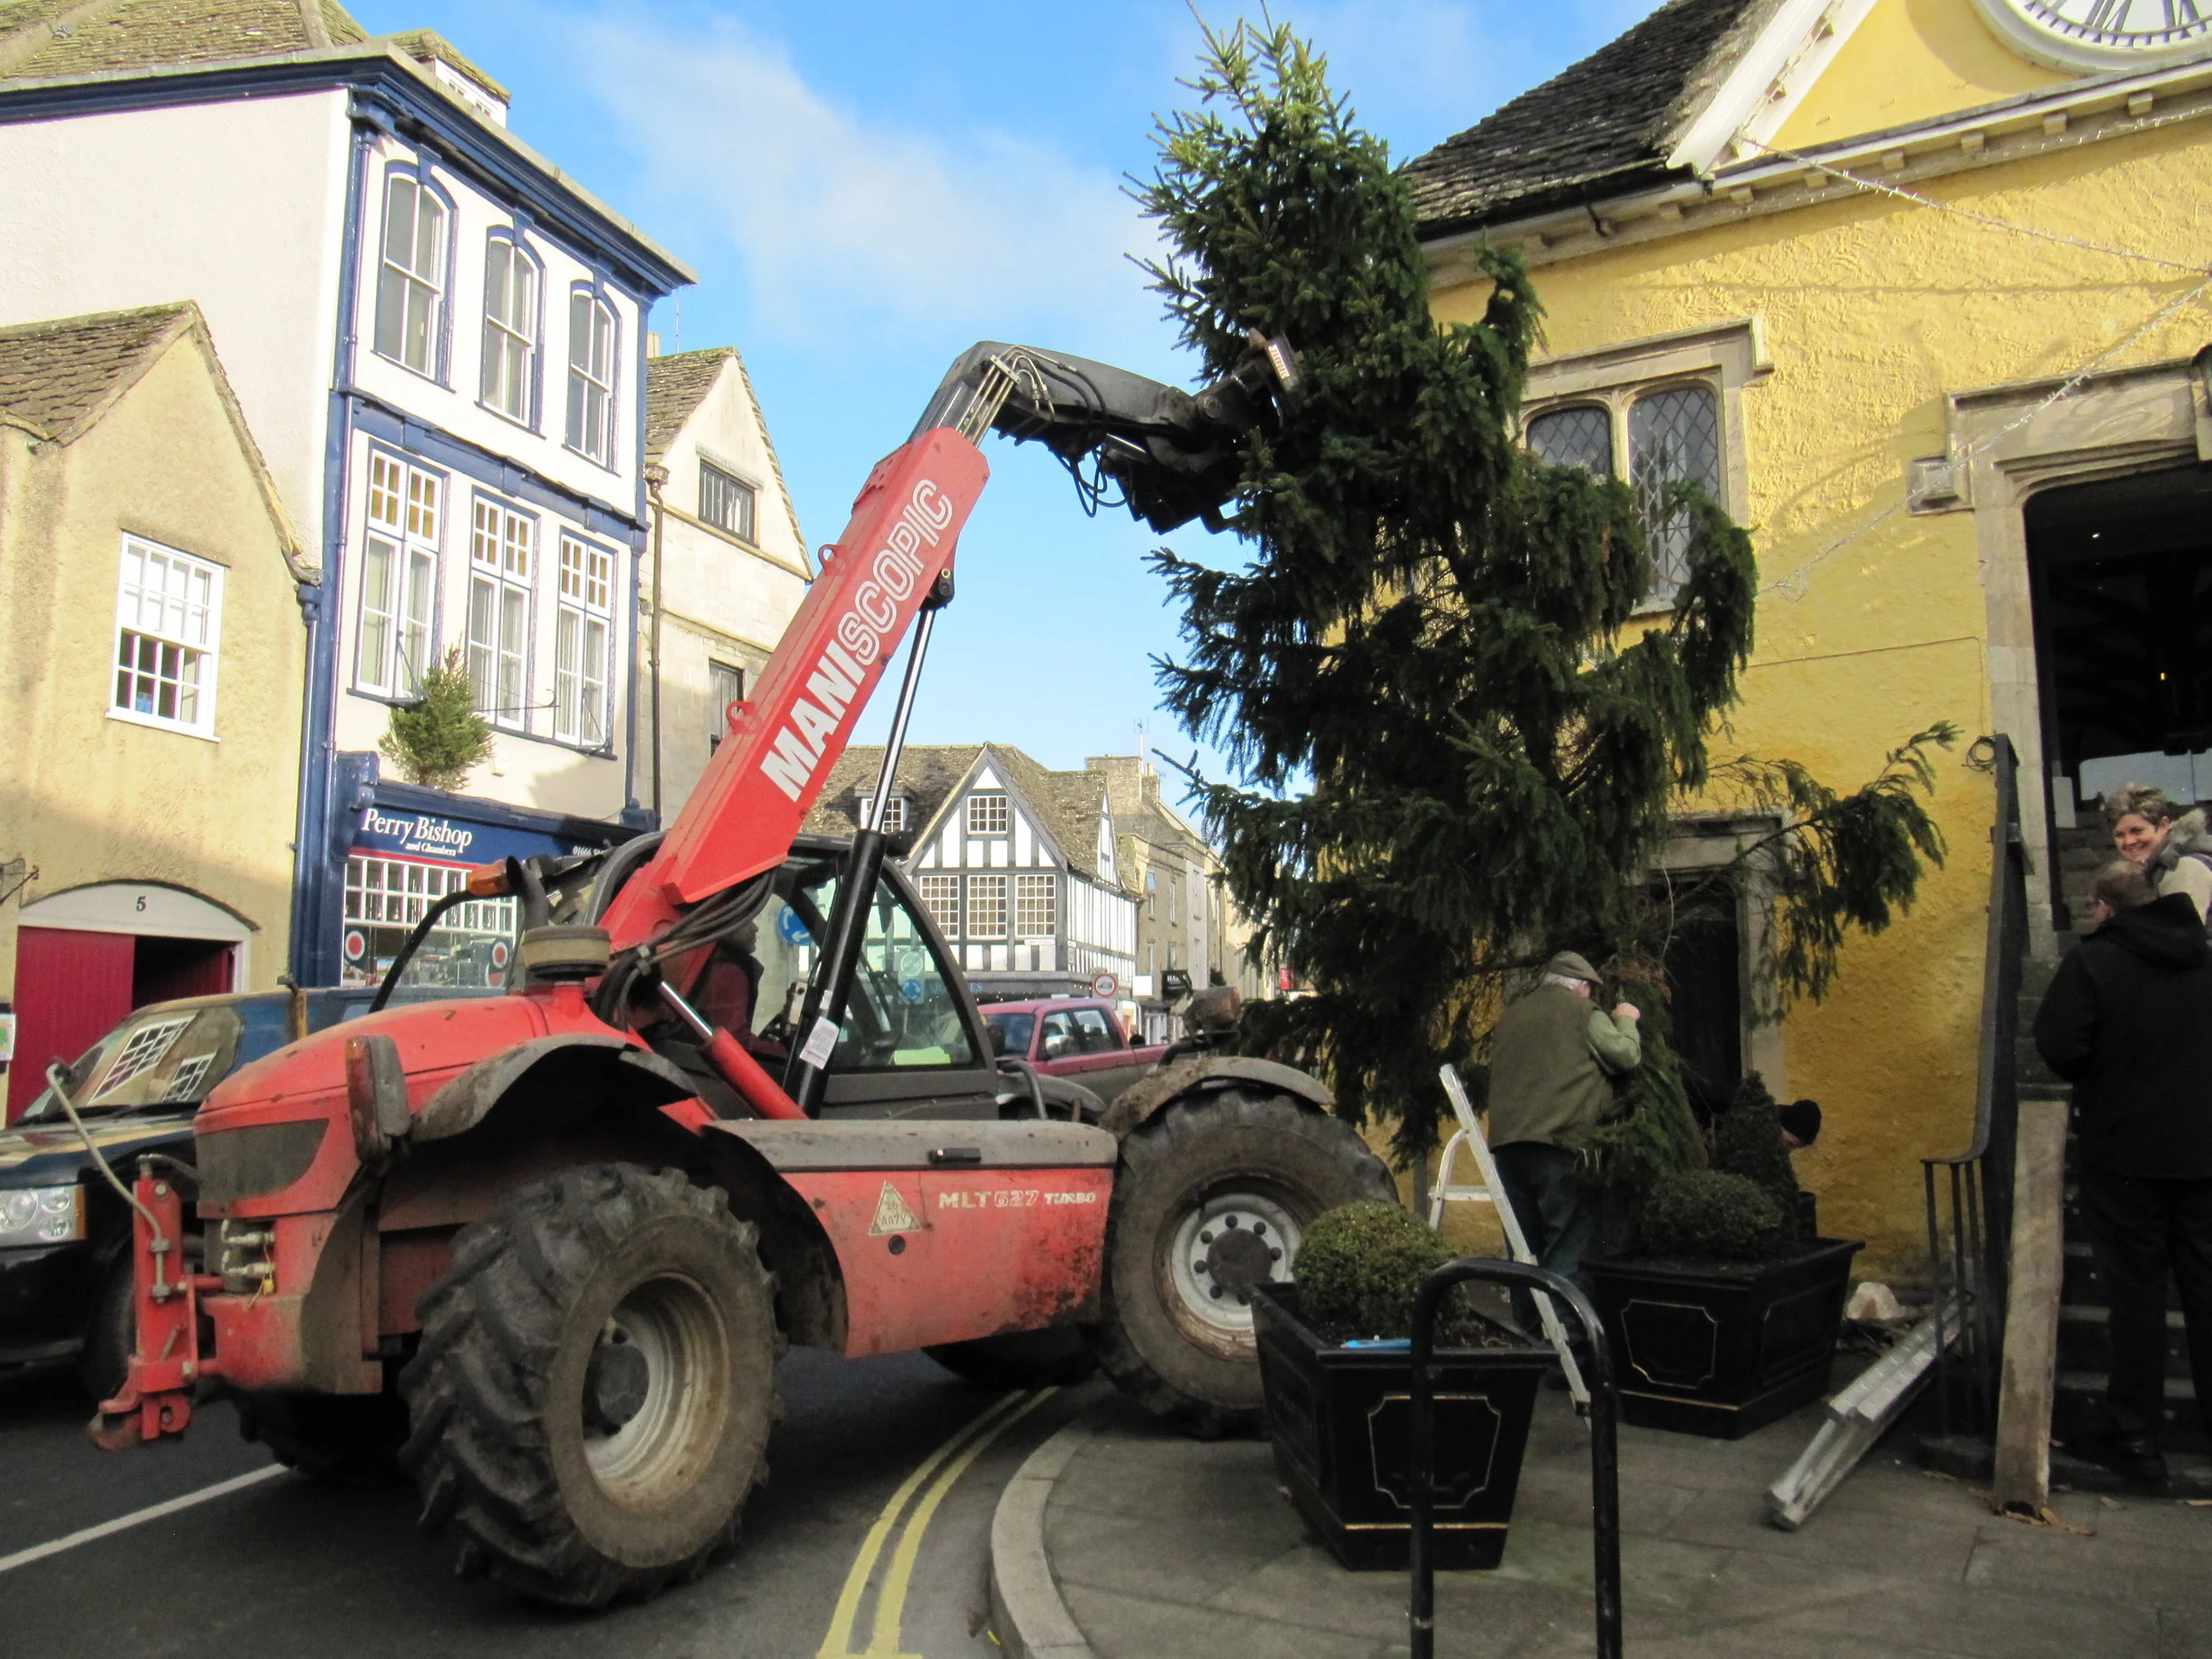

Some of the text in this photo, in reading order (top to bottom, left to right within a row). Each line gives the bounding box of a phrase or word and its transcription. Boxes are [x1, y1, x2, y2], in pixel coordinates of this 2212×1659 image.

[361, 808, 472, 854] Perry Bishop
[405, 841, 457, 857] and Chambers
[135, 895, 147, 912] 5
[939, 1190, 1096, 1209] MLT 627 TURBO
